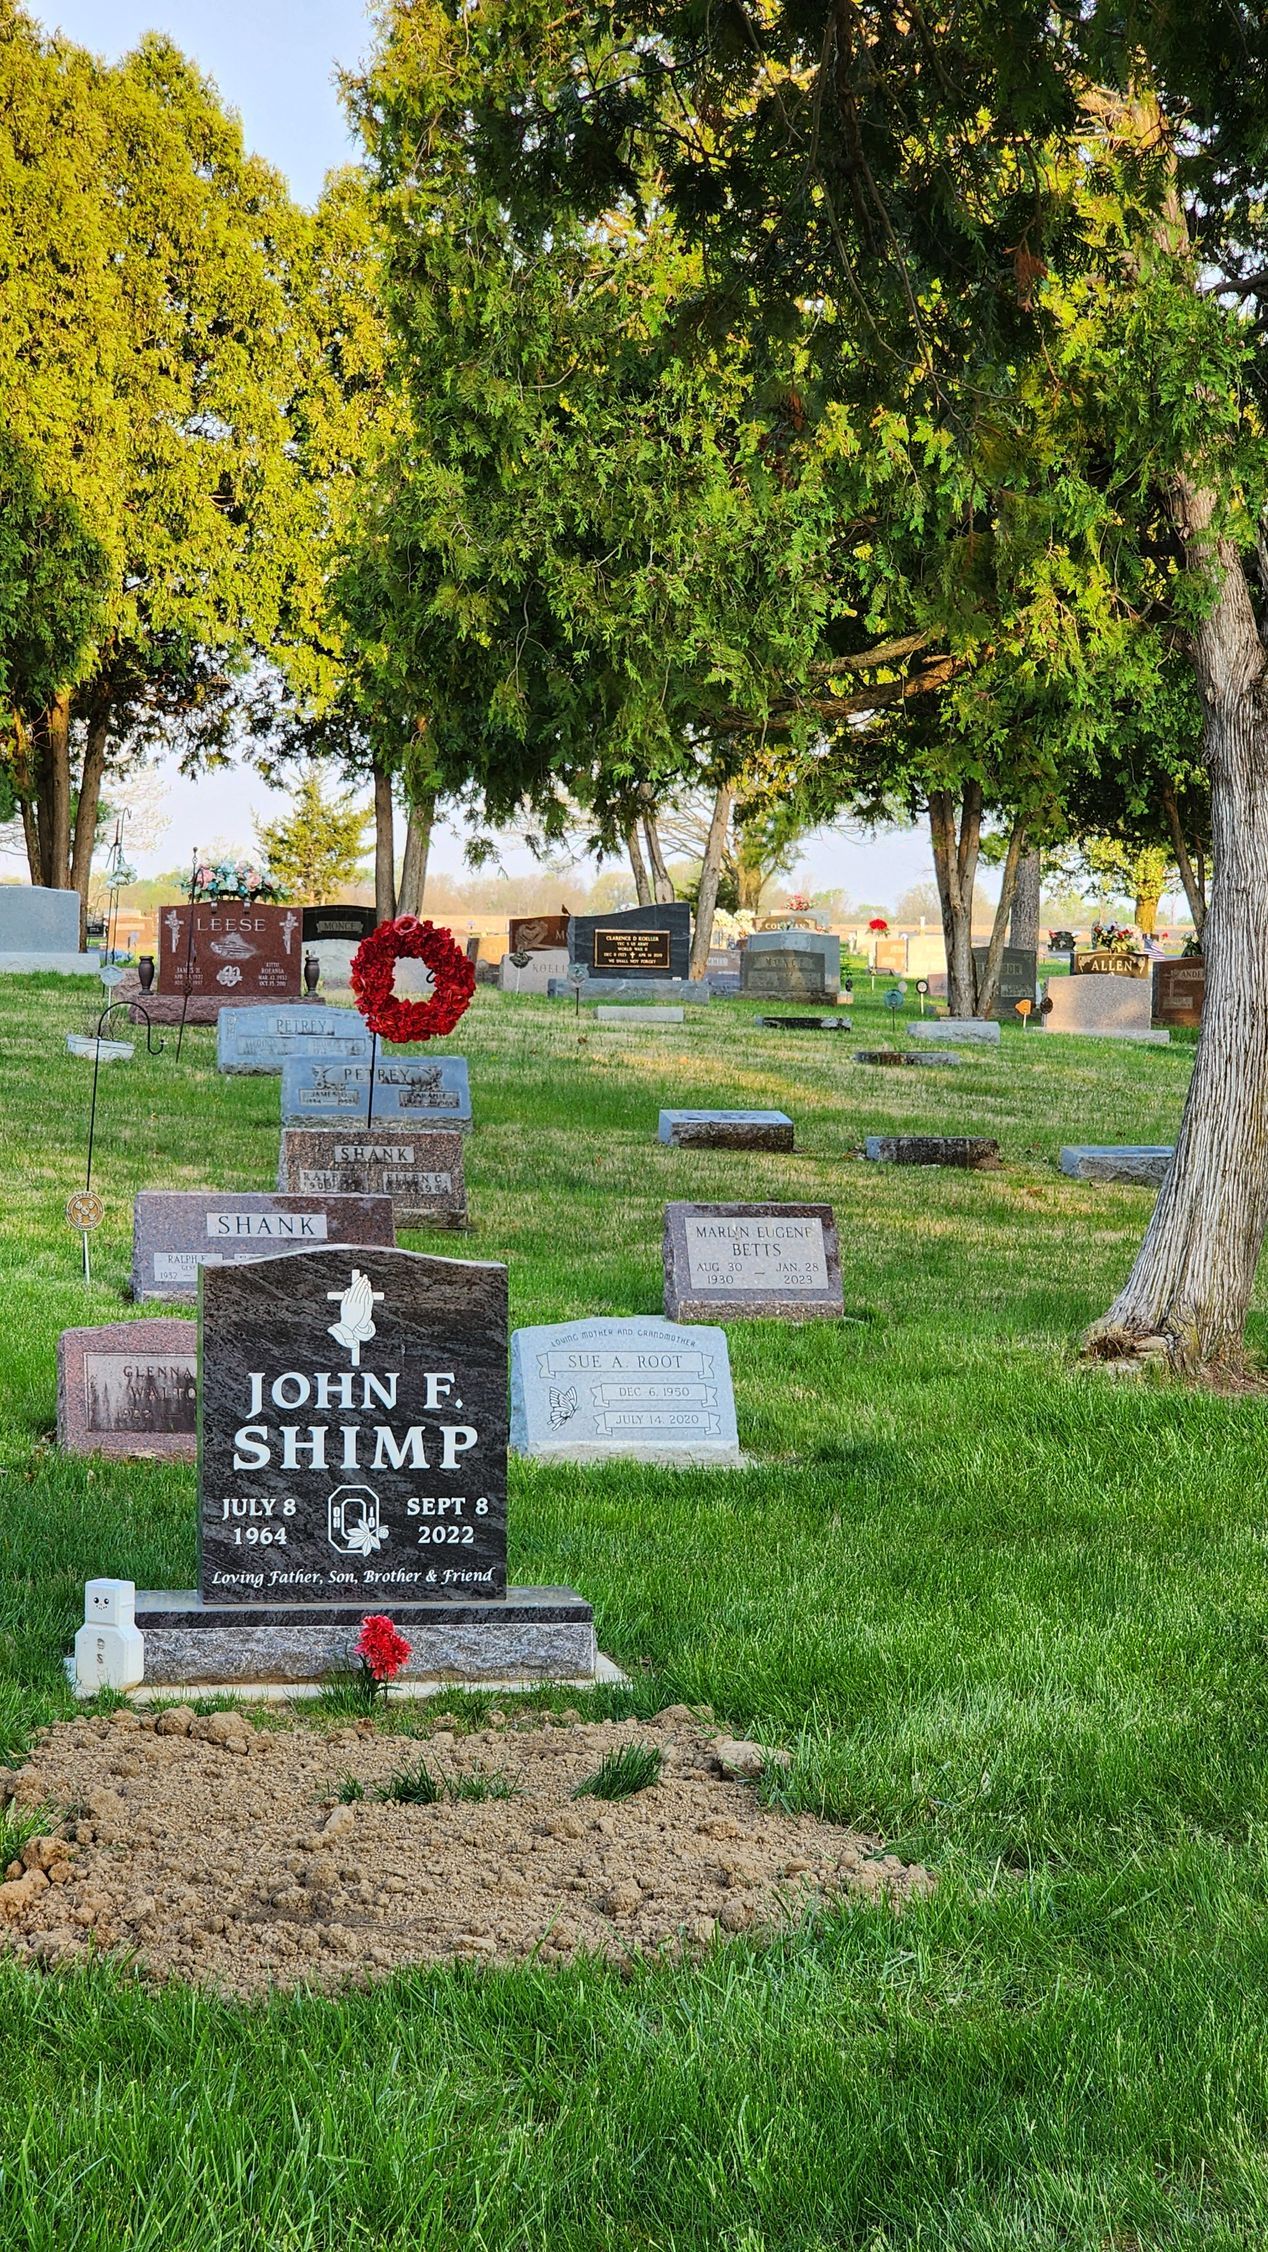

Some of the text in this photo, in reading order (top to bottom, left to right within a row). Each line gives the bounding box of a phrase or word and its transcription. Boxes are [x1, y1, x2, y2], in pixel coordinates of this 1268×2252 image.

[196, 918, 266, 932] LEESE
[1090, 960, 1133, 972] ALLEN
[276, 1019, 327, 1033] PETREY
[344, 1068, 410, 1081] PETREY
[341, 1147, 409, 1162] SHANK
[218, 1216, 316, 1235] SHANK
[696, 1226, 812, 1239] MARLYN EUGENE
[732, 1243, 782, 1257] BETTS
[168, 1254, 198, 1264] RALPH
[728, 1262, 743, 1272] 30
[805, 1262, 819, 1272] 28
[707, 1275, 734, 1285] 1930
[783, 1275, 813, 1285] 2023
[550, 1328, 696, 1348] LOVING MOTHER AND GRANDMOTHER
[568, 1355, 683, 1369] SUE A. ROOT
[123, 1365, 193, 1379] GLENNA
[245, 1372, 464, 1419] JOHN F.
[663, 1387, 690, 1397] 1950
[615, 1415, 643, 1425] JULY
[669, 1415, 699, 1425] 2020
[233, 1425, 478, 1470] SHIMP
[222, 1498, 297, 1521] JULY 8
[407, 1497, 489, 1516] SEPT 8
[233, 1526, 287, 1546] 1964
[418, 1525, 474, 1545] 2022
[212, 1566, 495, 1588] Loving Father, Son, Brother & Friend
